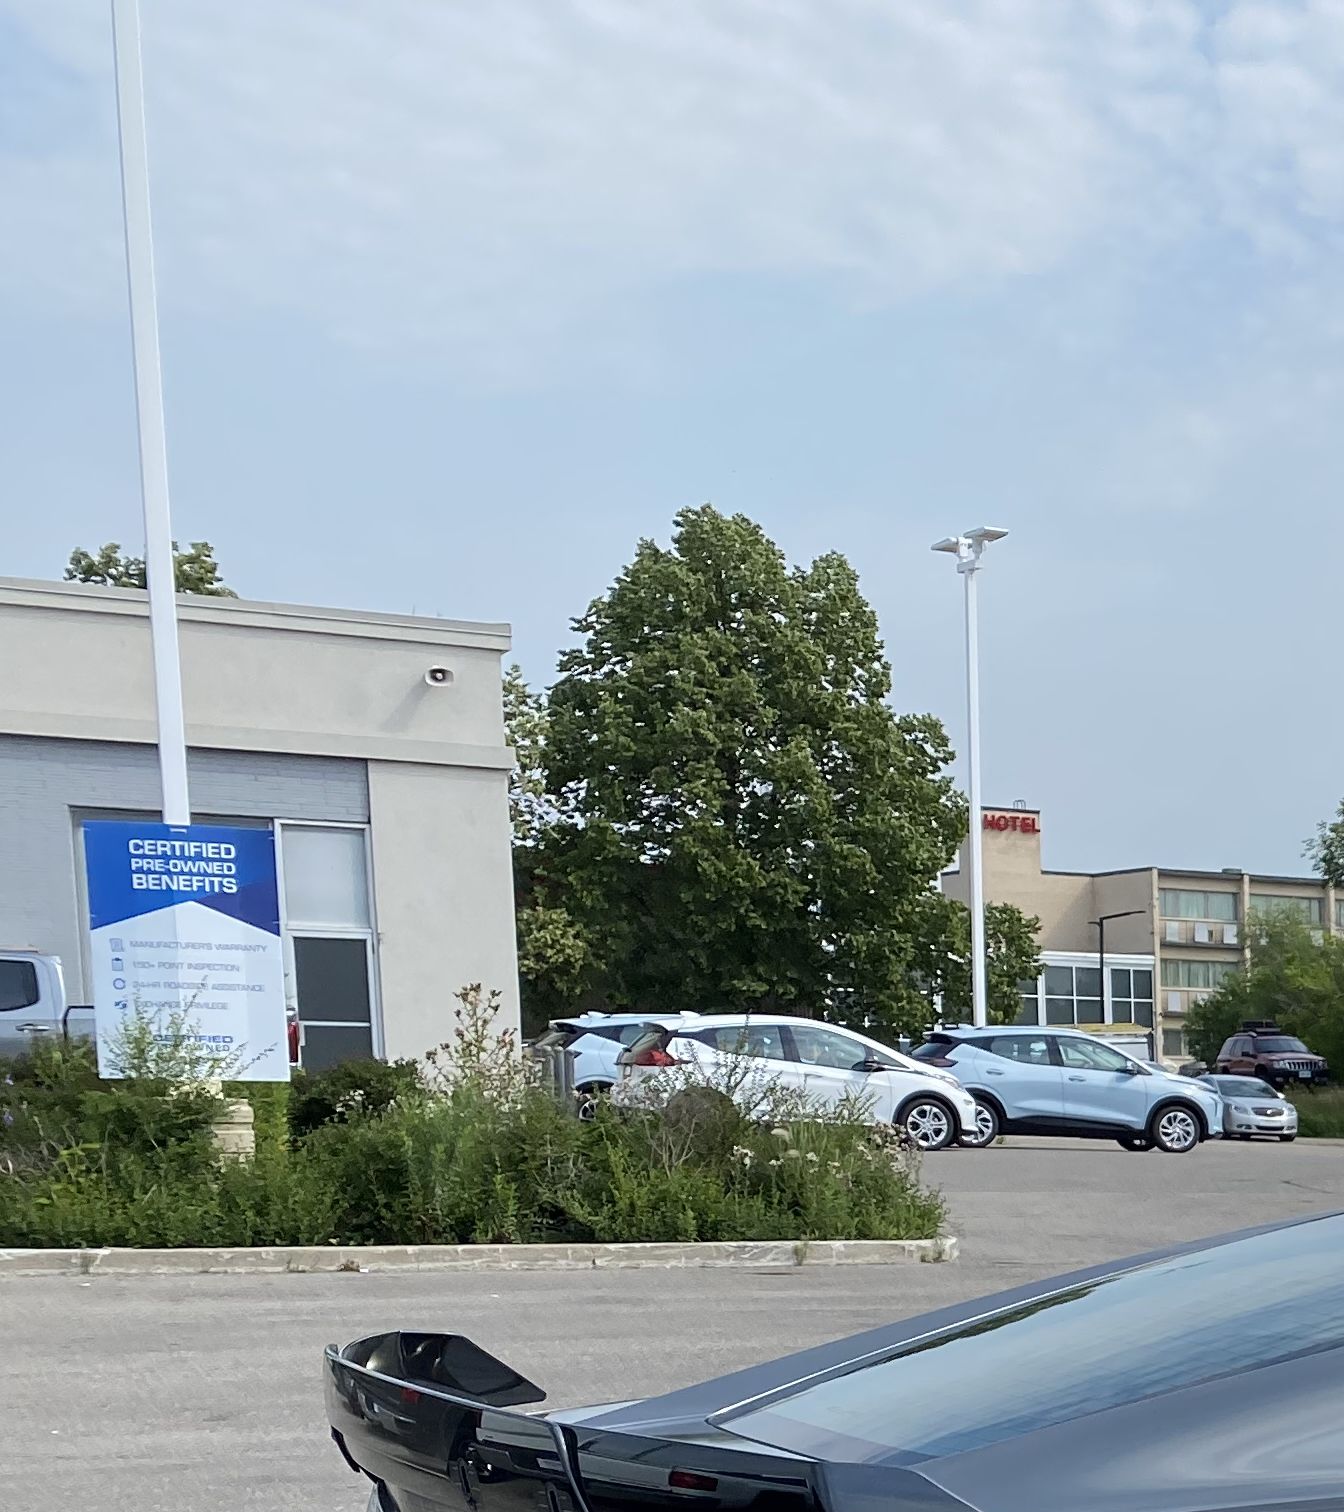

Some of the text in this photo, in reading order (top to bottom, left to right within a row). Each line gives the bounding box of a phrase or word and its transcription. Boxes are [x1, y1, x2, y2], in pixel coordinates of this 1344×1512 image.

[982, 813, 1040, 833] HOTEL
[128, 839, 236, 859] CERTIFIED
[131, 858, 236, 875] PRE-OWNED
[132, 874, 238, 893] BENEFITS
[214, 943, 268, 953] WARRANTY
[158, 961, 185, 971] POINT
[187, 962, 240, 973] INSPECTION
